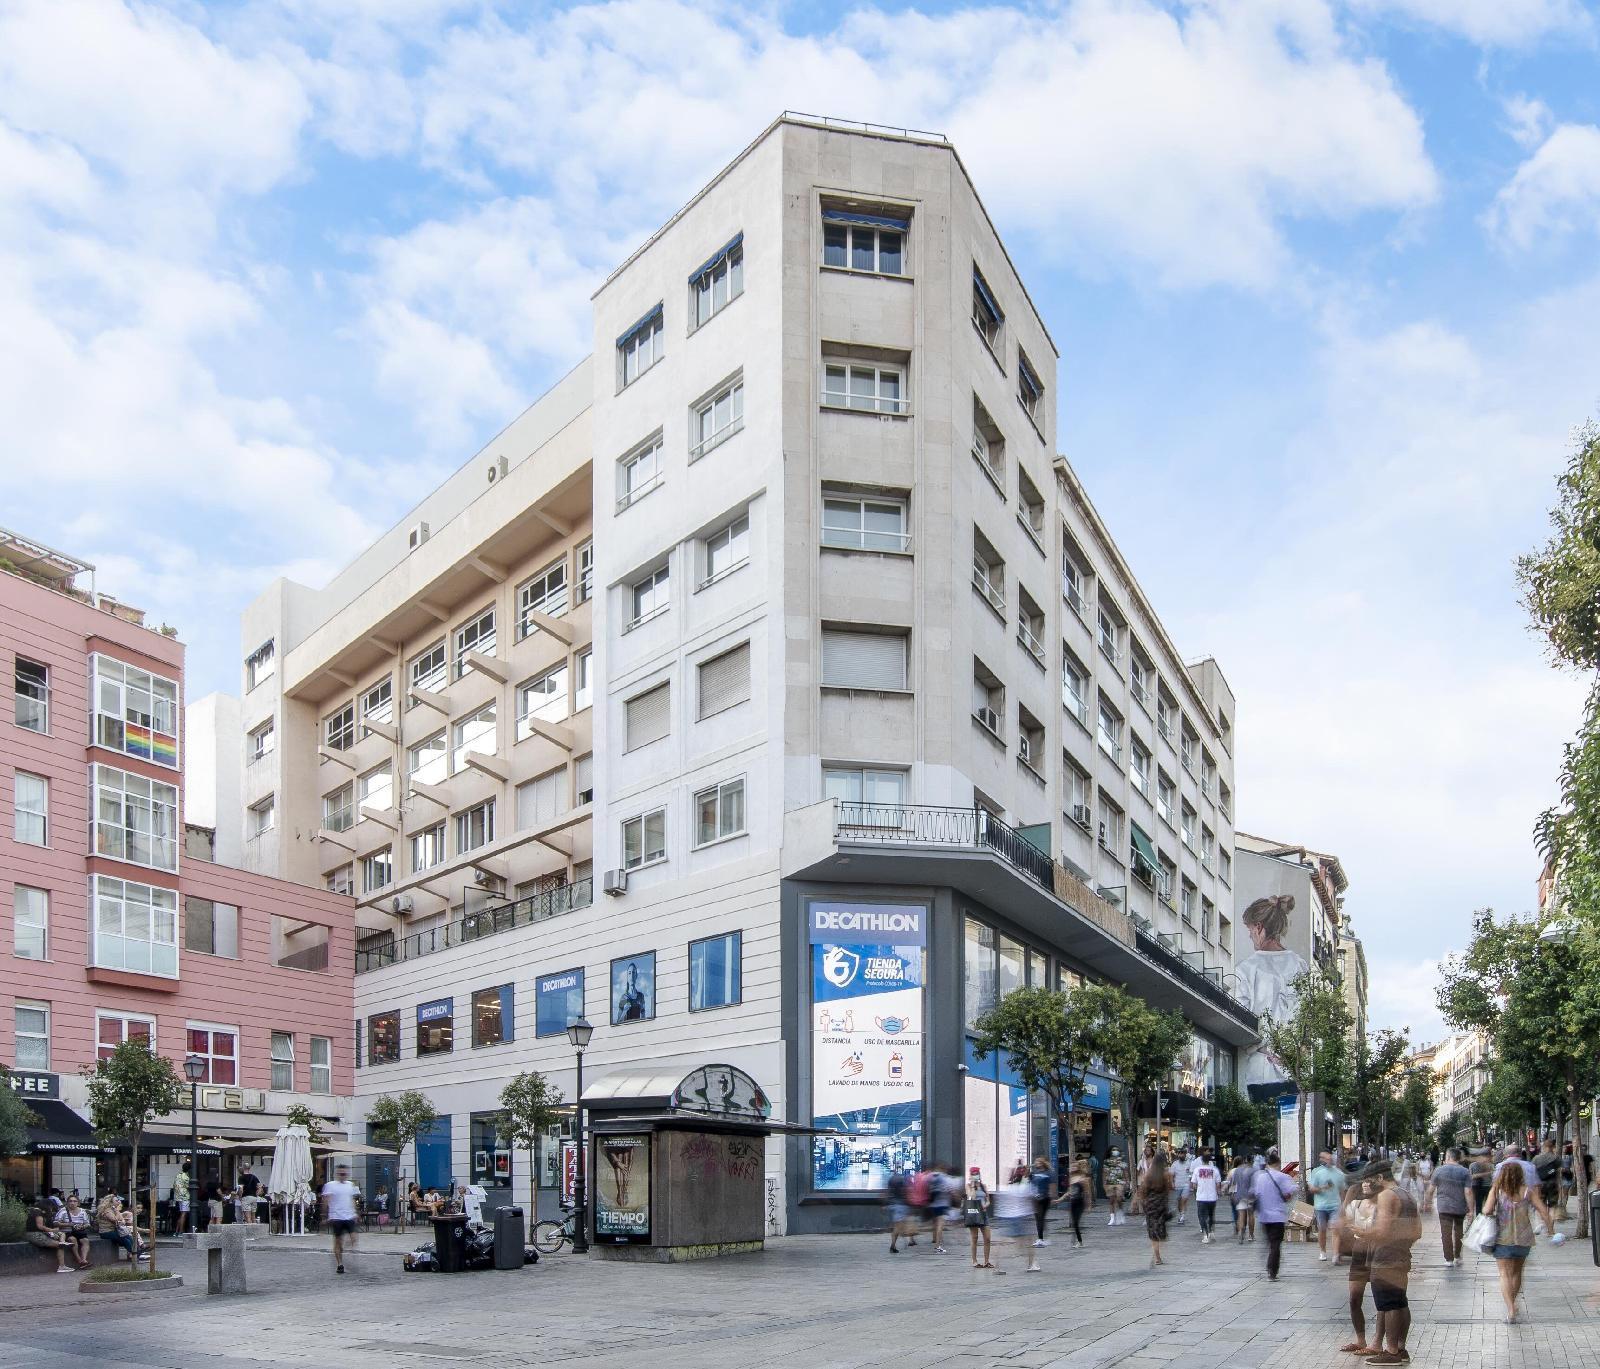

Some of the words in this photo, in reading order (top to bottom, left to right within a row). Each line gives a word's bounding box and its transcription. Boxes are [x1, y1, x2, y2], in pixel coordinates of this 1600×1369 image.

[815, 912, 919, 931] DECATHLON
[867, 957, 902, 970] TIENDA
[864, 968, 904, 980] SEGURA
[542, 976, 576, 992] DECATHLON
[422, 1005, 448, 1018] DECATHLON
[600, 1211, 645, 1225] TIEMPO
